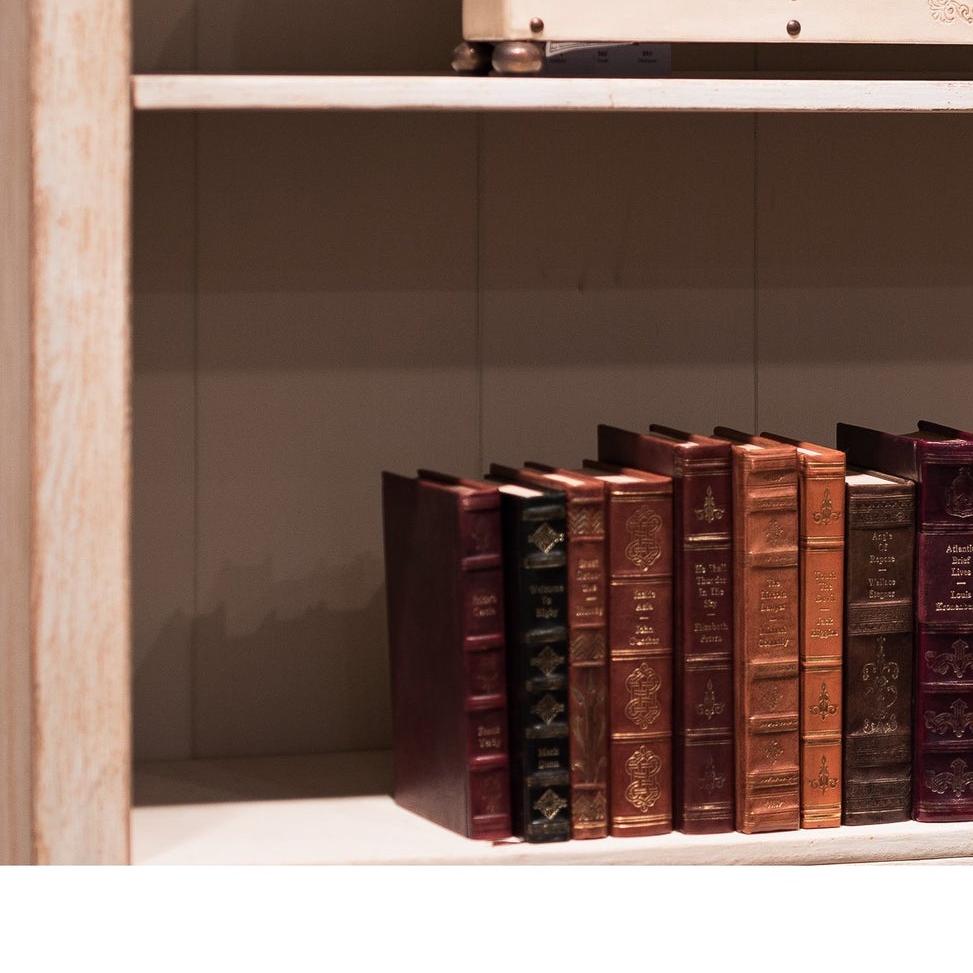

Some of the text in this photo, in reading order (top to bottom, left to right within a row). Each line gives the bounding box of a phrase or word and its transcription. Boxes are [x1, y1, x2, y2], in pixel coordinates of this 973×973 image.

[951, 556, 972, 565] Brief
[951, 567, 972, 576] Lives
[950, 590, 972, 599] Louis
